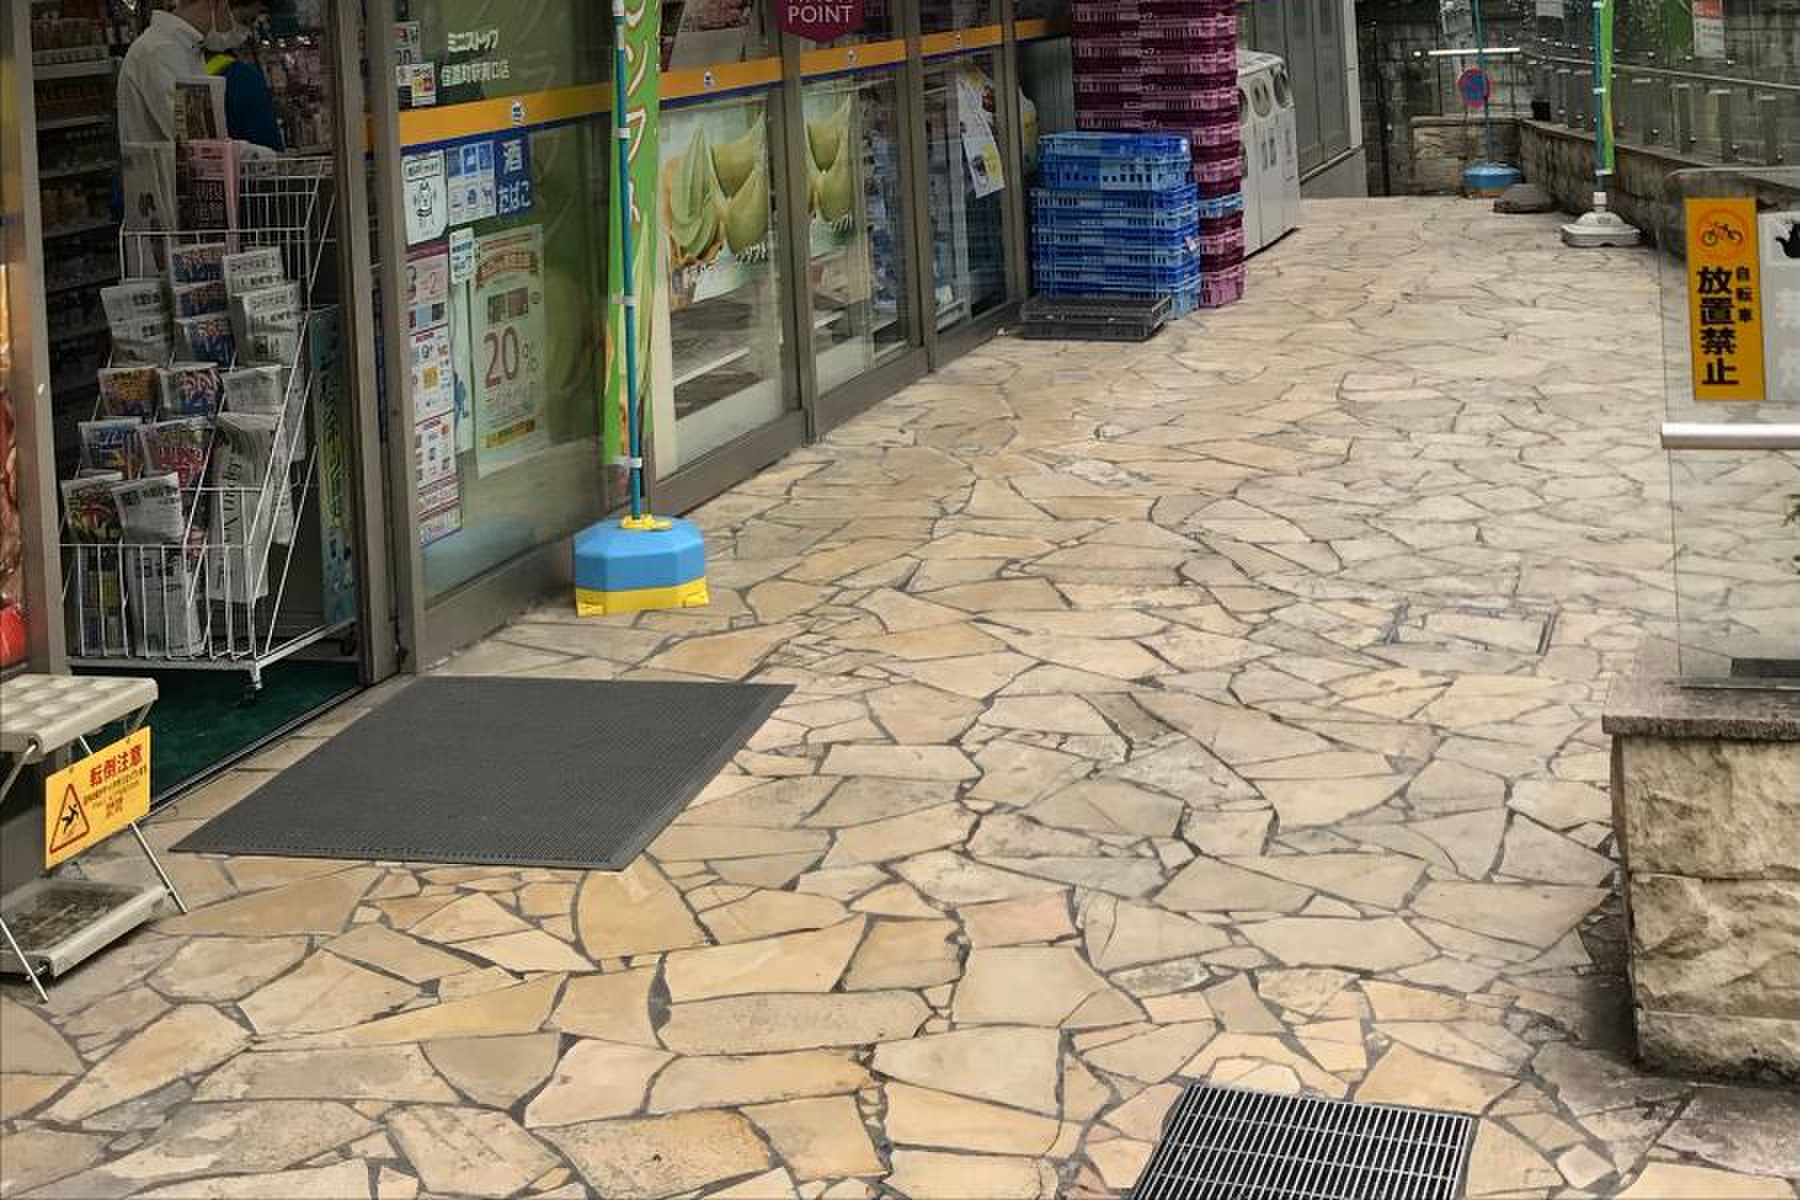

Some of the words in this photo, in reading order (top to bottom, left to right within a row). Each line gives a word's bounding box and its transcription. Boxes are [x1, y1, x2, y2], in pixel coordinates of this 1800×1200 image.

[788, 5, 854, 24] POINT
[498, 180, 532, 215] たばこ
[1735, 266, 1754, 324] 自転車
[1697, 265, 1740, 385] 放置禁止
[89, 744, 143, 787] 転倒注意
